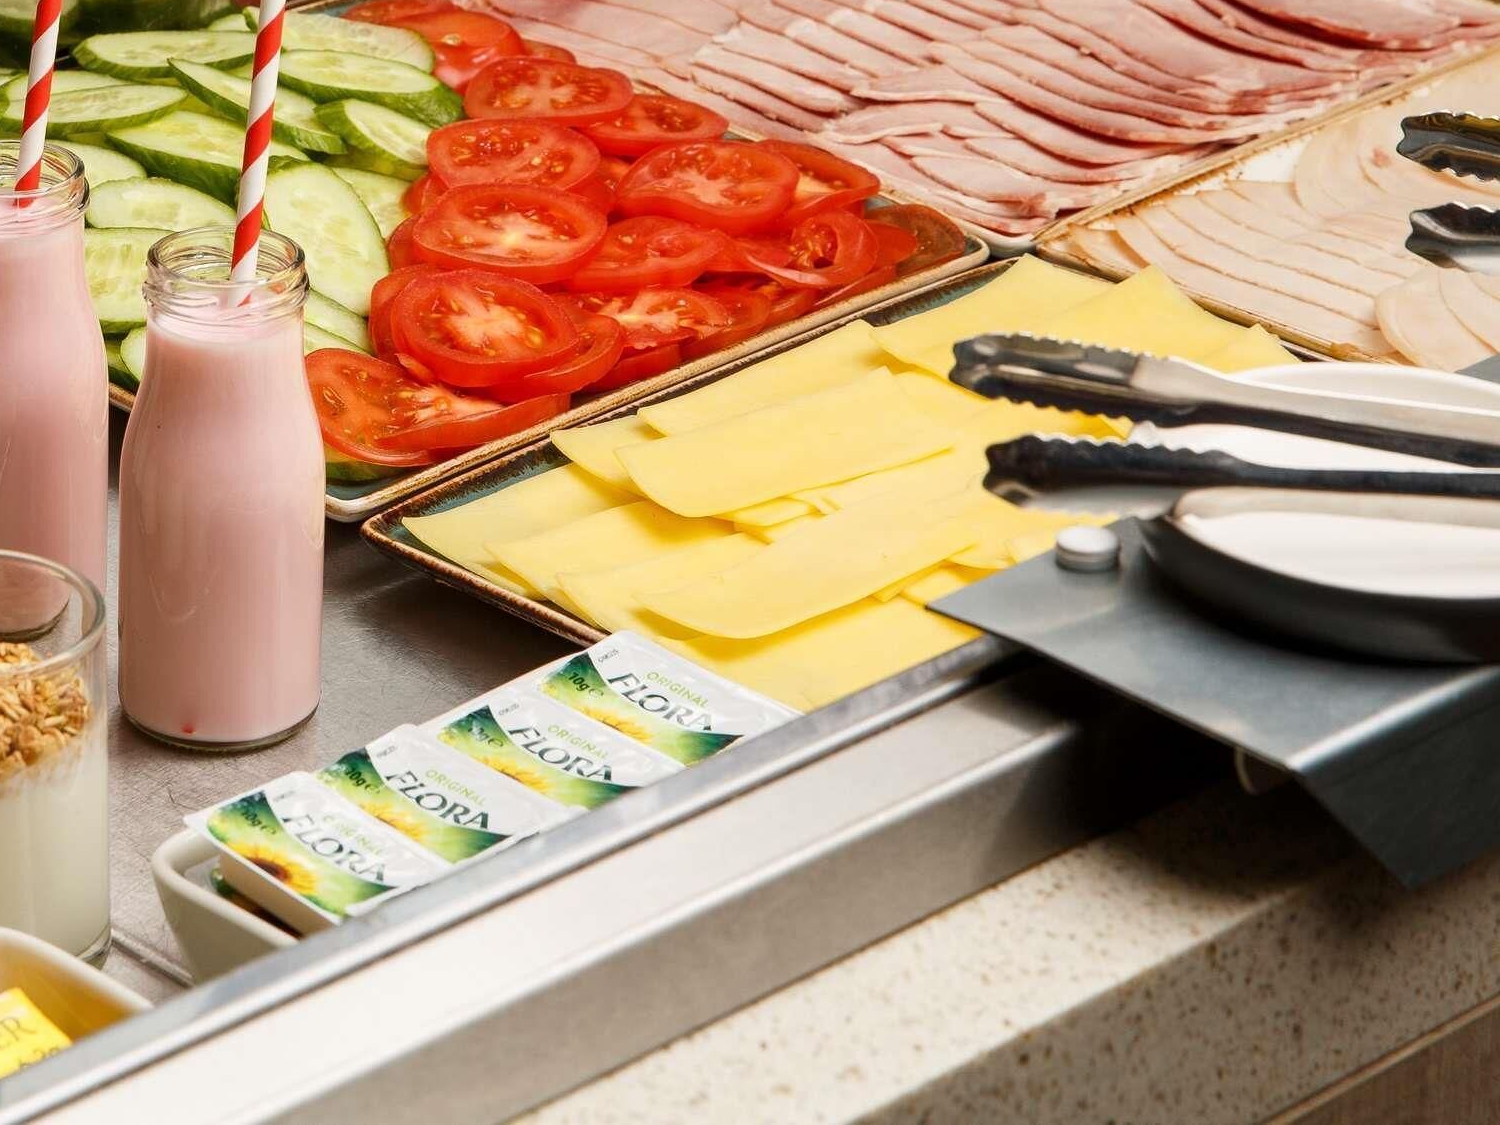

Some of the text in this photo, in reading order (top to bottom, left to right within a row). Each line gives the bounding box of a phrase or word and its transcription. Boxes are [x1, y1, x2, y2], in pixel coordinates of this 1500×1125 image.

[608, 673, 713, 731] FLORA
[646, 671, 709, 708] ORIGINAL
[508, 726, 613, 781] FLORA
[548, 724, 610, 760] ORIGINAL
[386, 770, 490, 830] FLORA
[425, 769, 486, 807] ORIGINAL
[282, 815, 386, 882] FLORA
